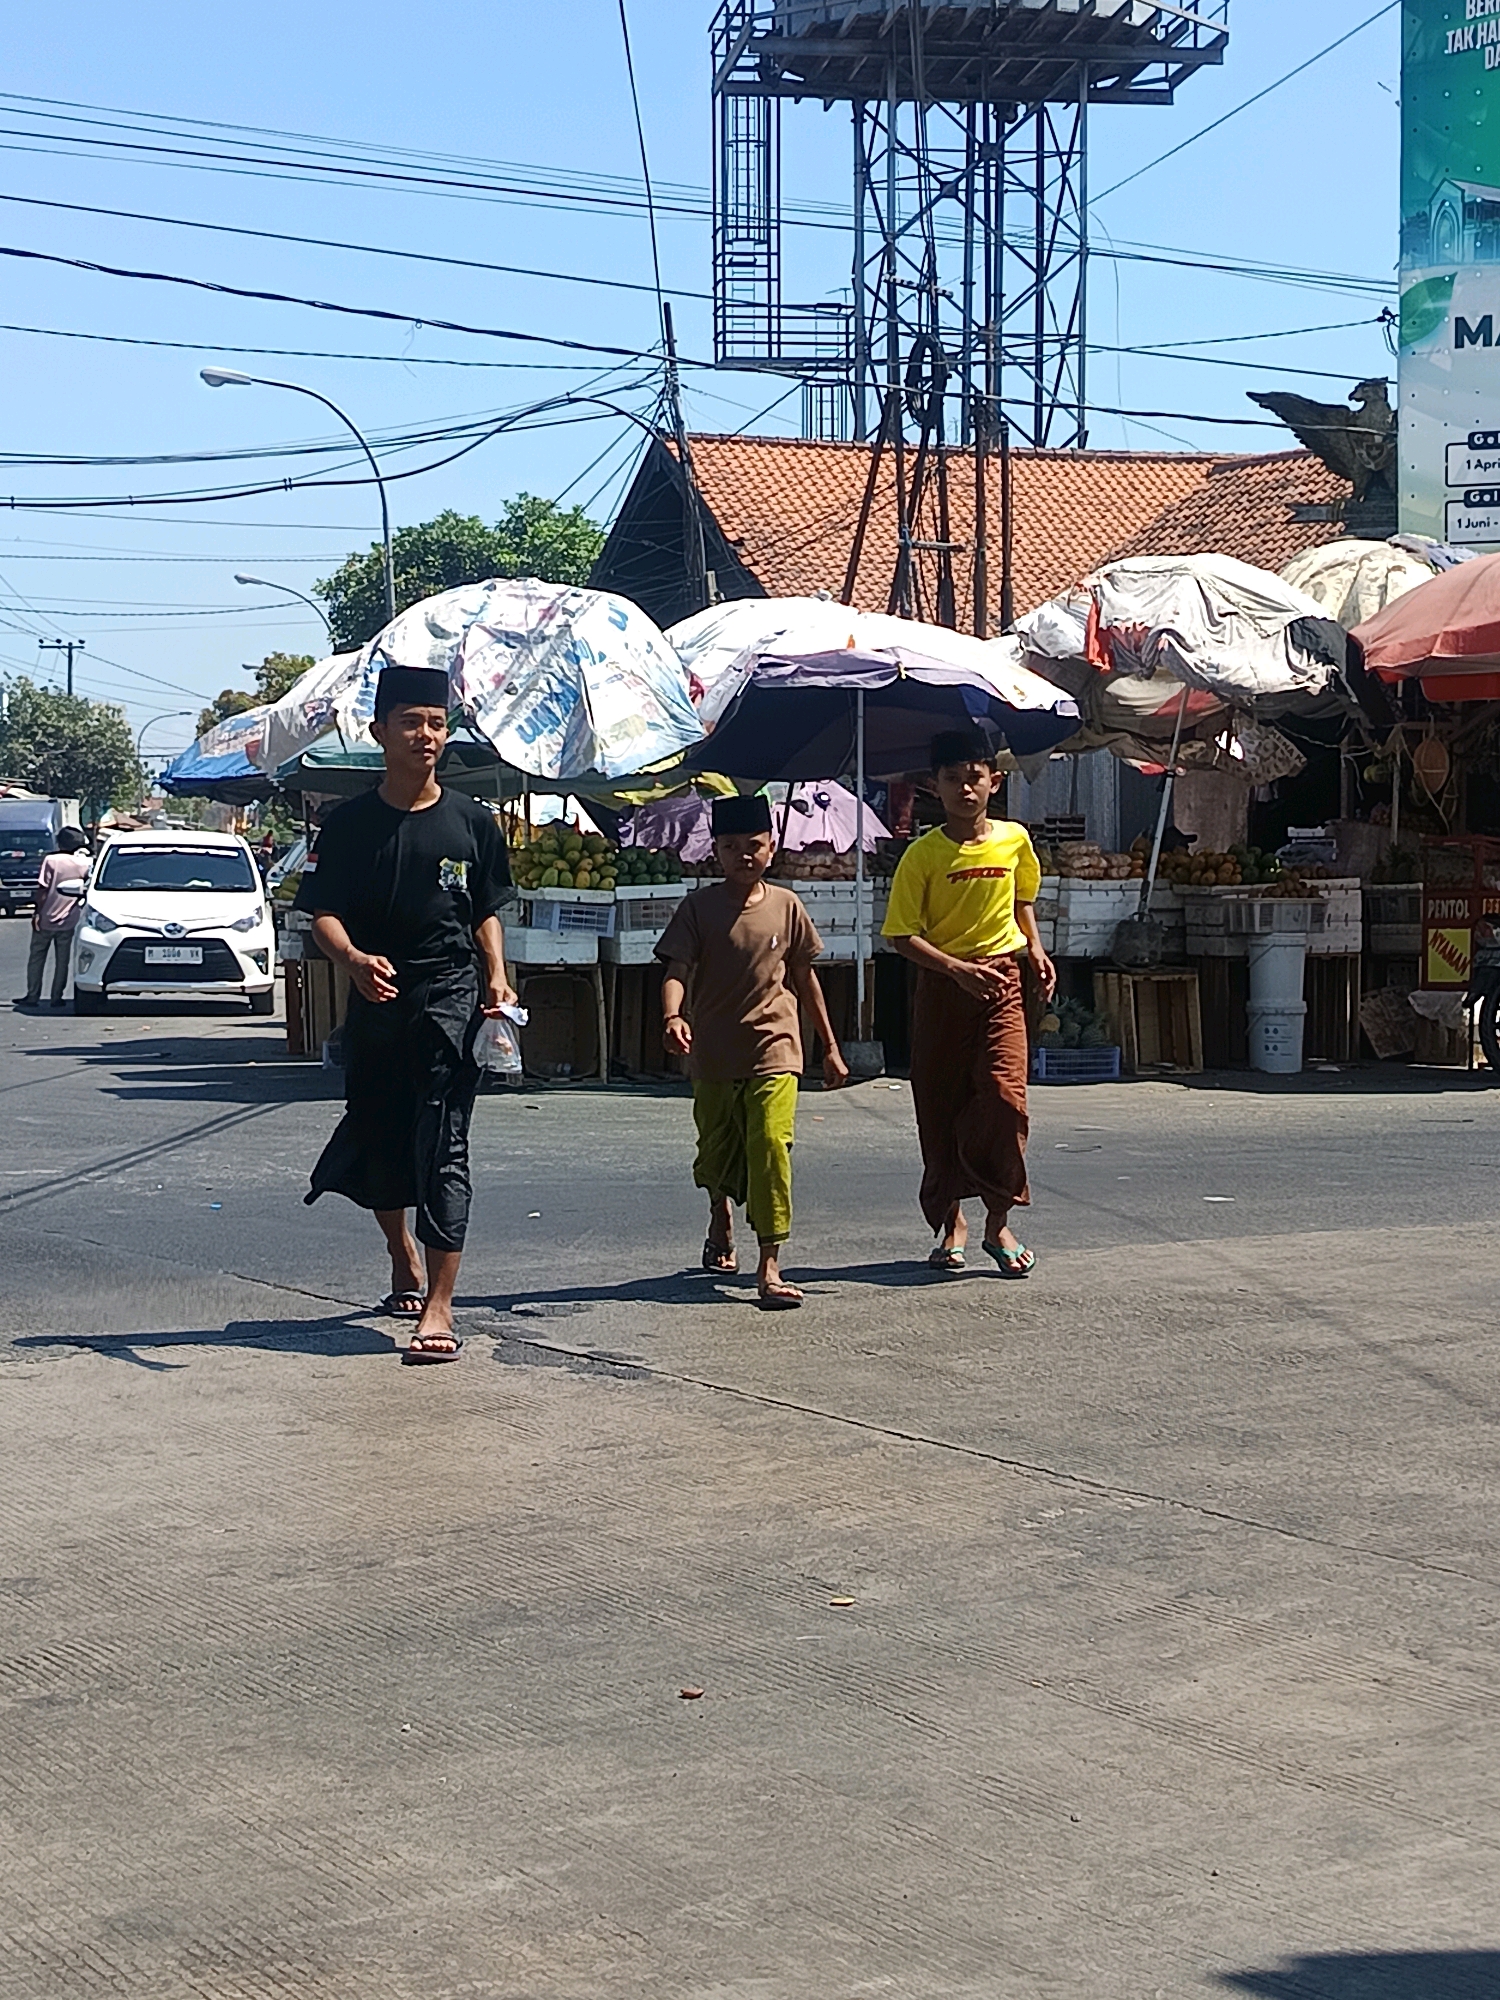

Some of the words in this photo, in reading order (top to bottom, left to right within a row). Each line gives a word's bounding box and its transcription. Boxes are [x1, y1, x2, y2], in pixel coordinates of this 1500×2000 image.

[1446, 24, 1475, 54] TAK
[1454, 314, 1500, 349] M
[1465, 516, 1491, 529] Juni
[1427, 899, 1470, 920] PENTOL
[1429, 929, 1471, 977] NYAMAN
